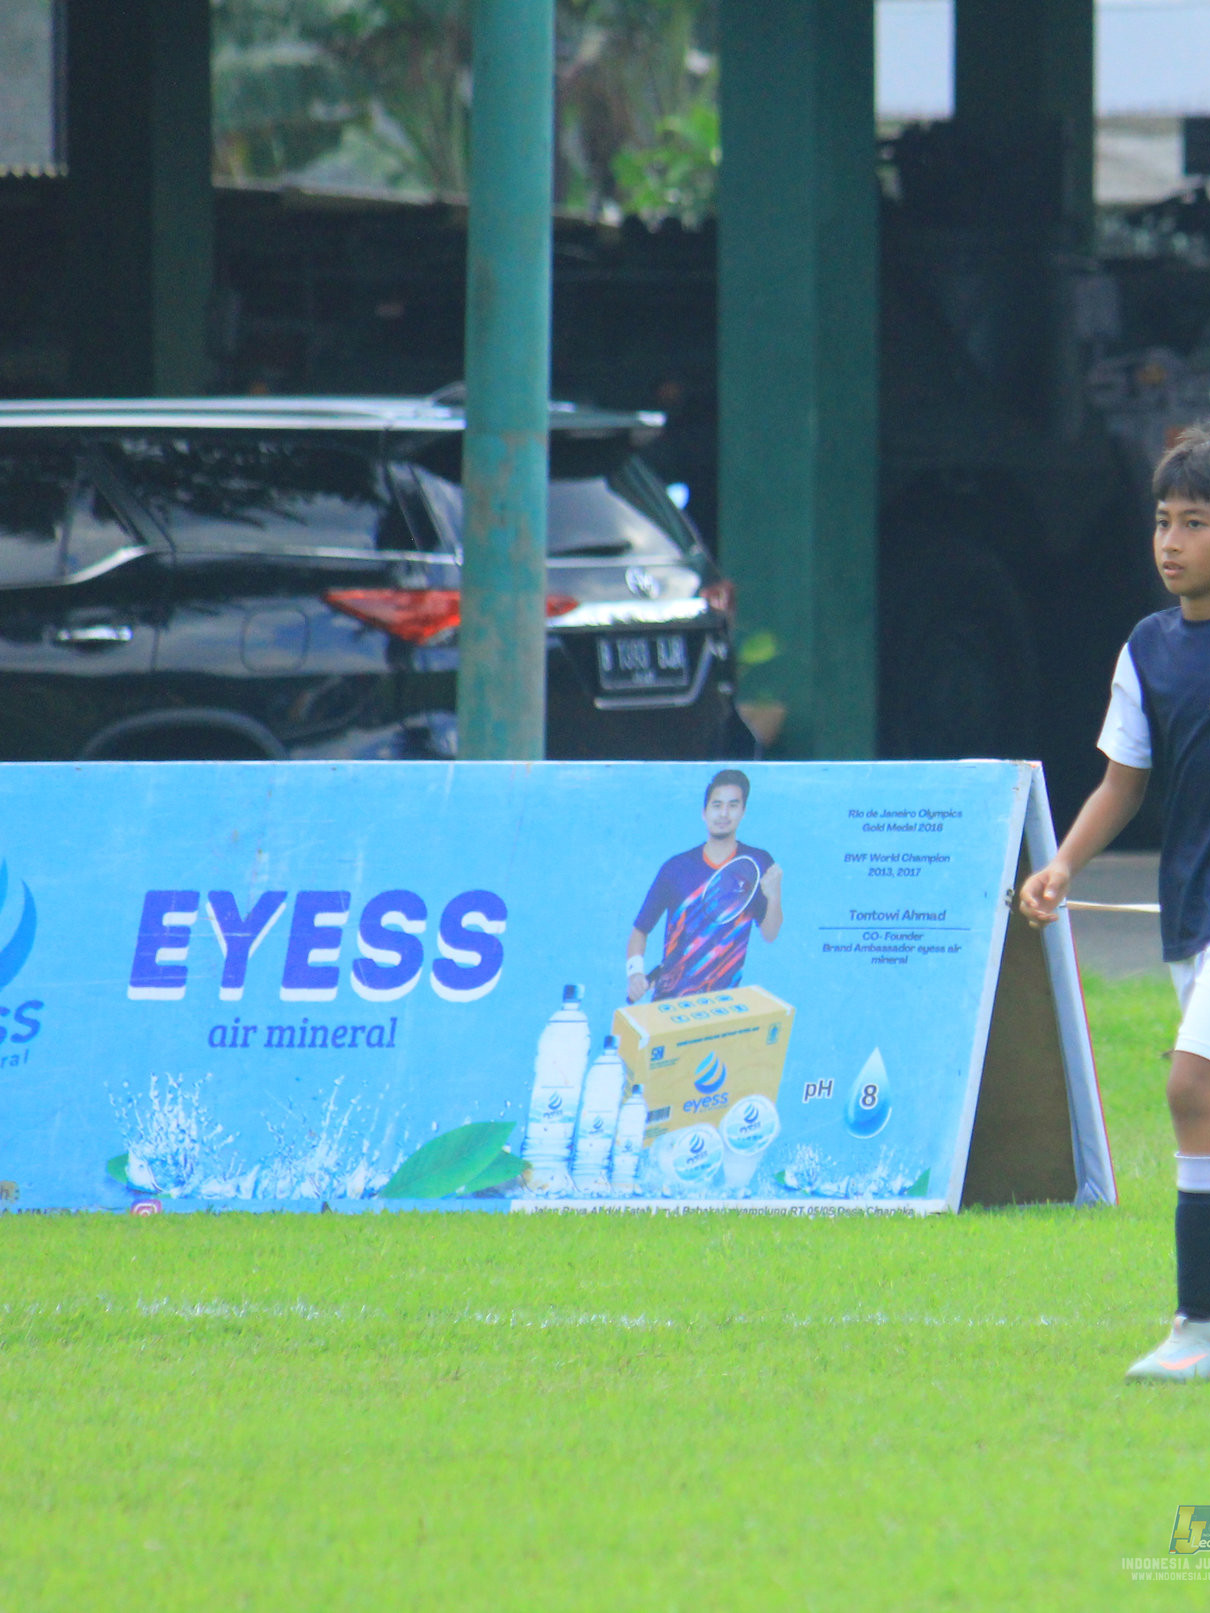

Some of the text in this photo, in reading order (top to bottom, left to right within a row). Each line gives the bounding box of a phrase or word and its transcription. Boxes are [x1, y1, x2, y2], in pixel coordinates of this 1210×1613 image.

[848, 809, 963, 820] Rio de Janeiro Olympics
[862, 823, 885, 832] Gold
[886, 823, 916, 832] Medal
[844, 853, 950, 864] BWF World Champion
[897, 868, 921, 876] 2017
[849, 910, 946, 921] Tontowi Ahmad
[885, 932, 923, 941] Founder
[127, 889, 508, 1002] EYESS
[823, 944, 853, 953] Brand
[854, 944, 915, 953] Ambassador
[871, 955, 908, 964] mineral
[207, 1017, 398, 1049] air mineral
[804, 1079, 833, 1102] pH
[861, 1084, 877, 1107] 8
[683, 1092, 728, 1113] eyess
